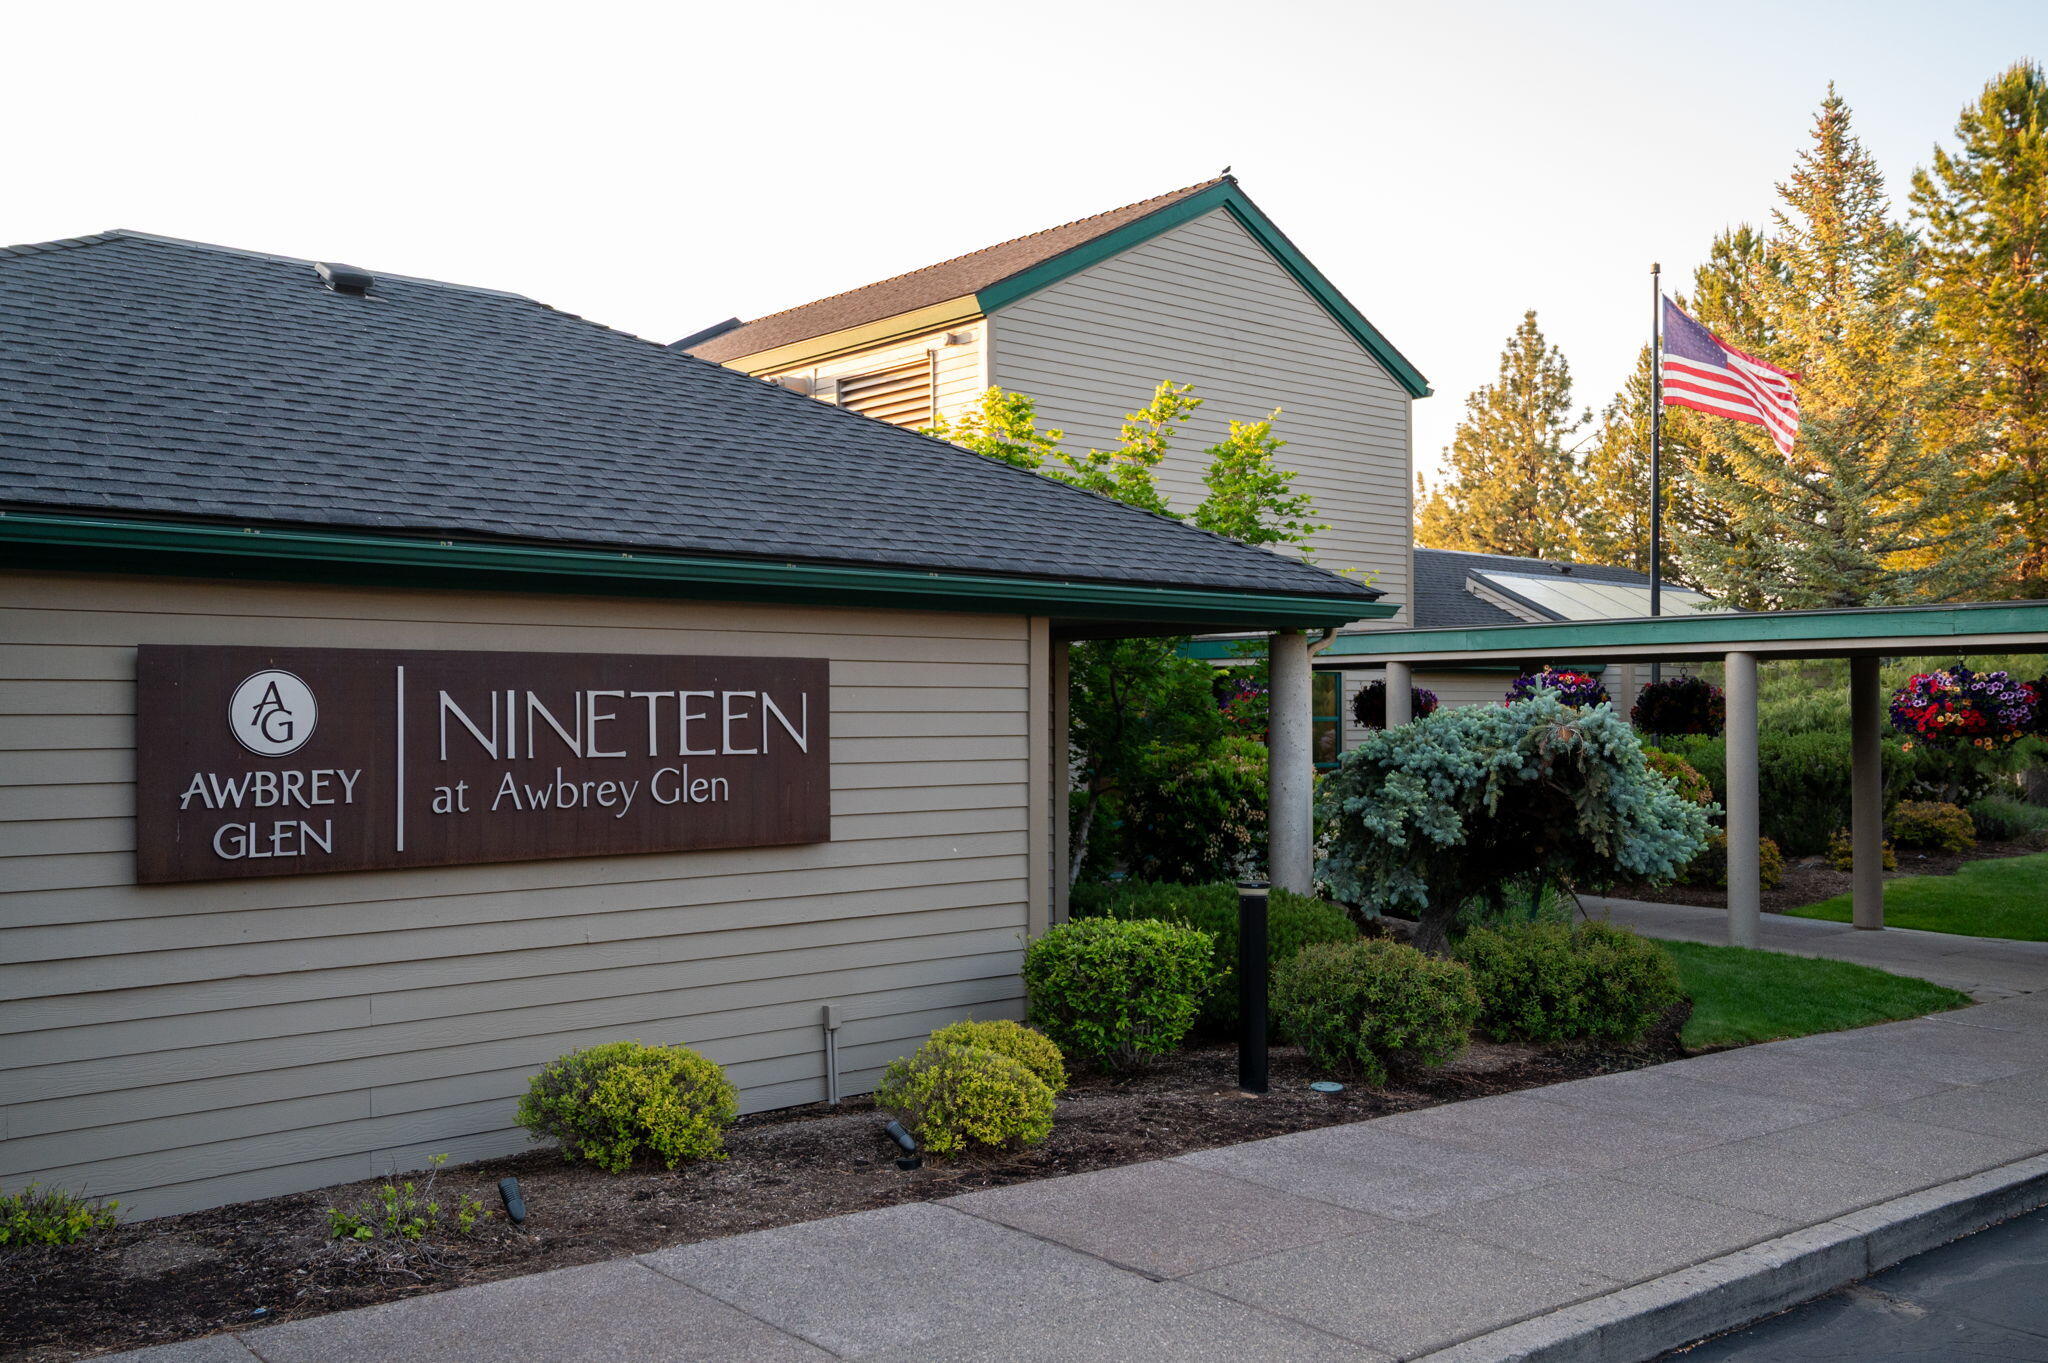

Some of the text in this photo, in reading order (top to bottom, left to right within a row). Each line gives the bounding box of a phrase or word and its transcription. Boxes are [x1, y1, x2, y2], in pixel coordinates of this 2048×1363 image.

[439, 690, 808, 761] NINETEEN
[180, 769, 361, 810] AWBREY
[432, 763, 729, 819] at Awbrey Glen
[213, 819, 332, 860] GLEN
